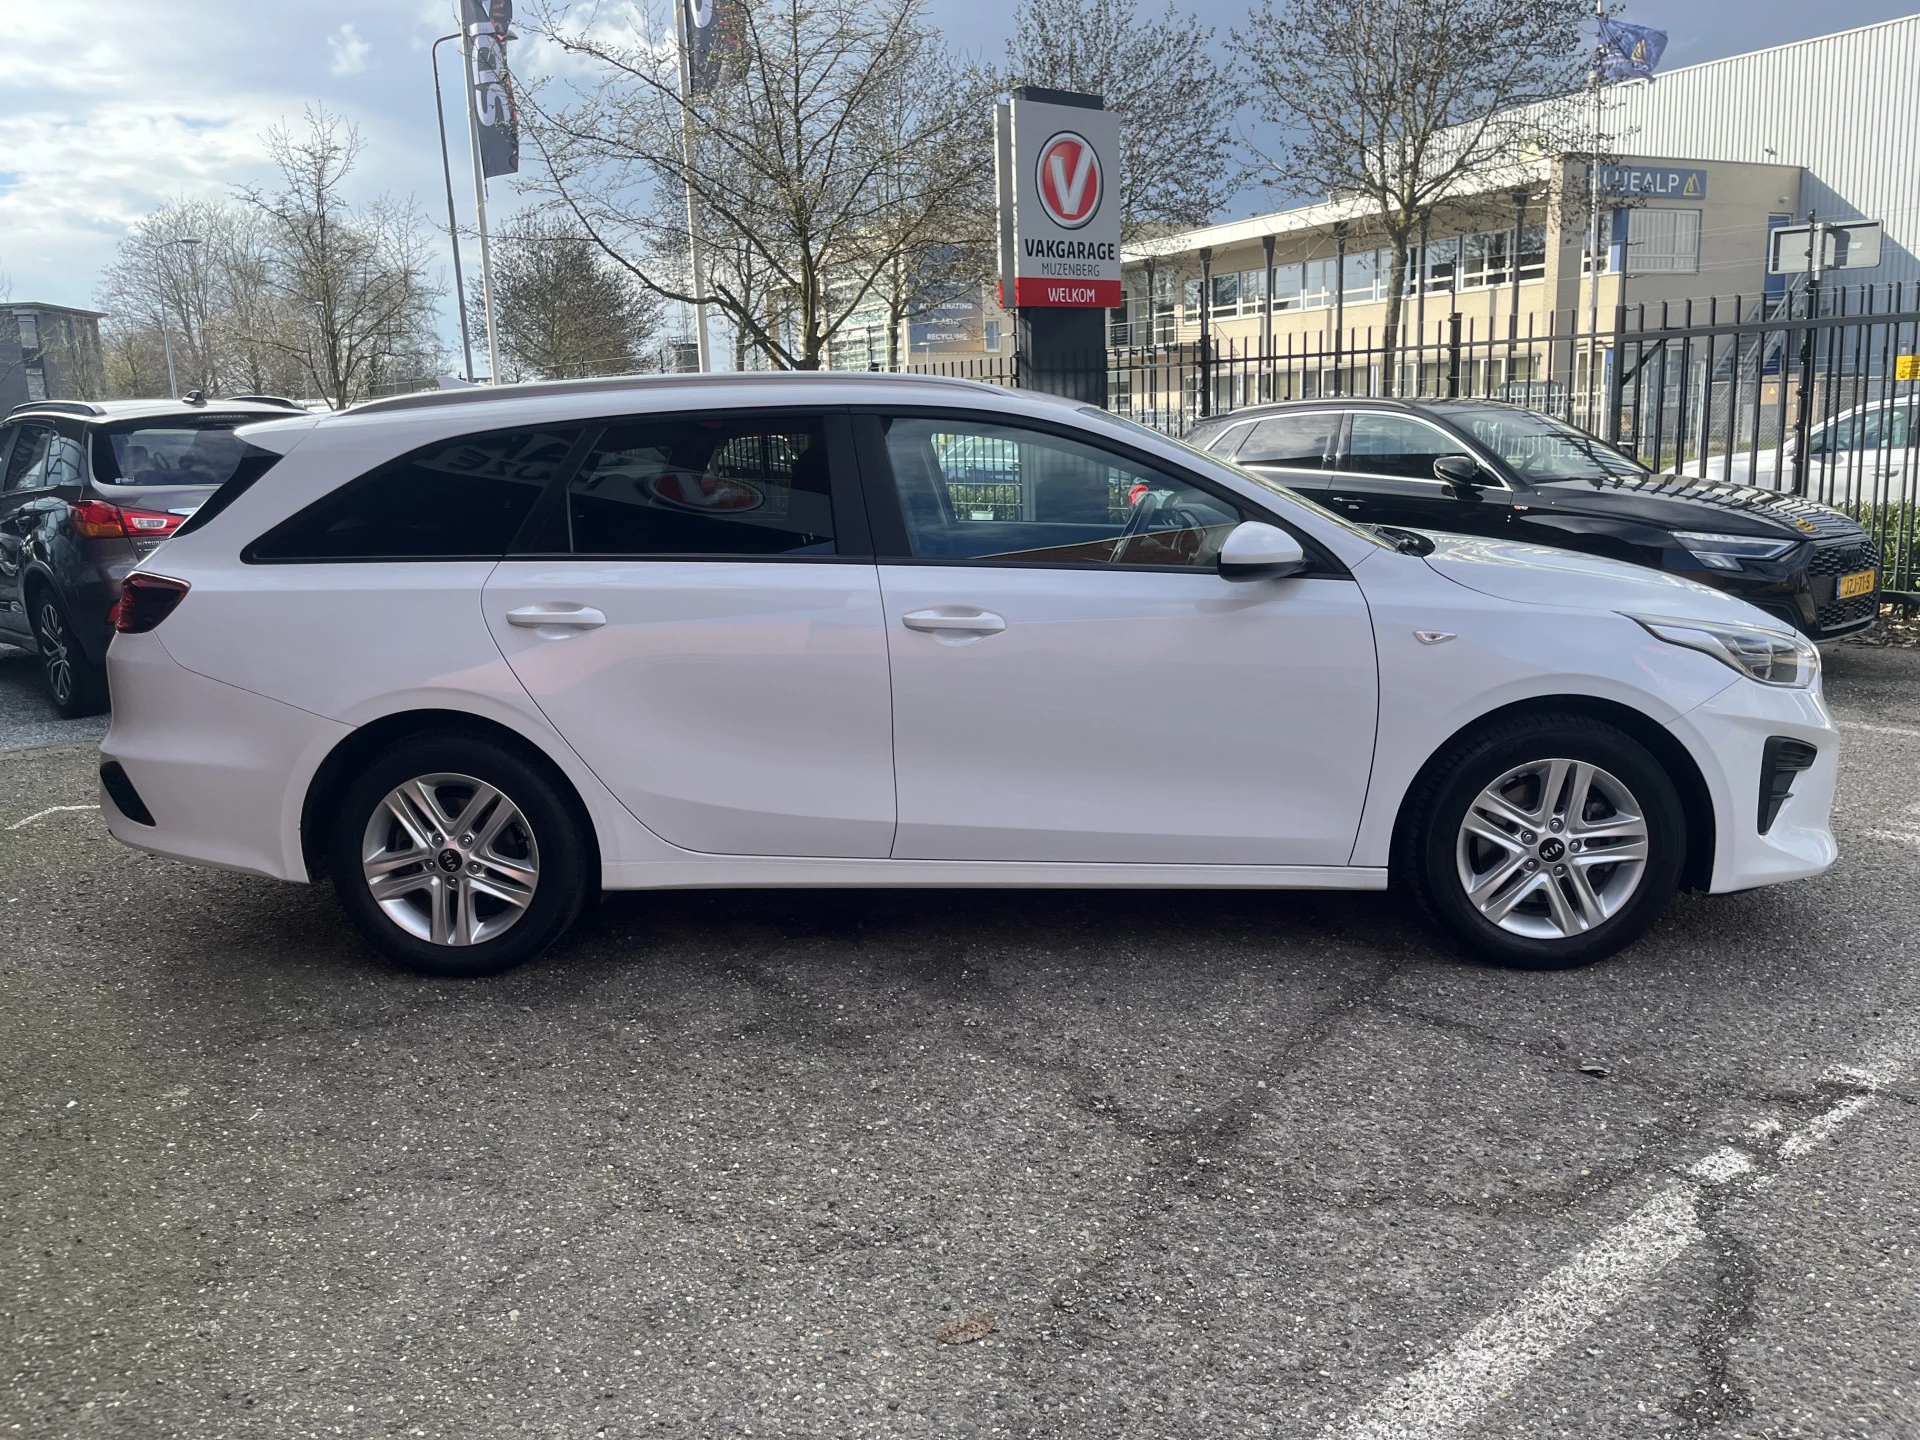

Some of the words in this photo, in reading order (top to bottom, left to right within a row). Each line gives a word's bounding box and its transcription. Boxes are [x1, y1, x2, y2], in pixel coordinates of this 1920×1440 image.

[1024, 239, 1115, 261] VAKGARAGE
[1041, 263, 1100, 277] MUZENBERG
[1048, 287, 1096, 303] WELKOM
[918, 302, 973, 310] ACLERATING
[1845, 574, 1870, 594] JZJ-71-S
[1541, 843, 1562, 858] KIA
